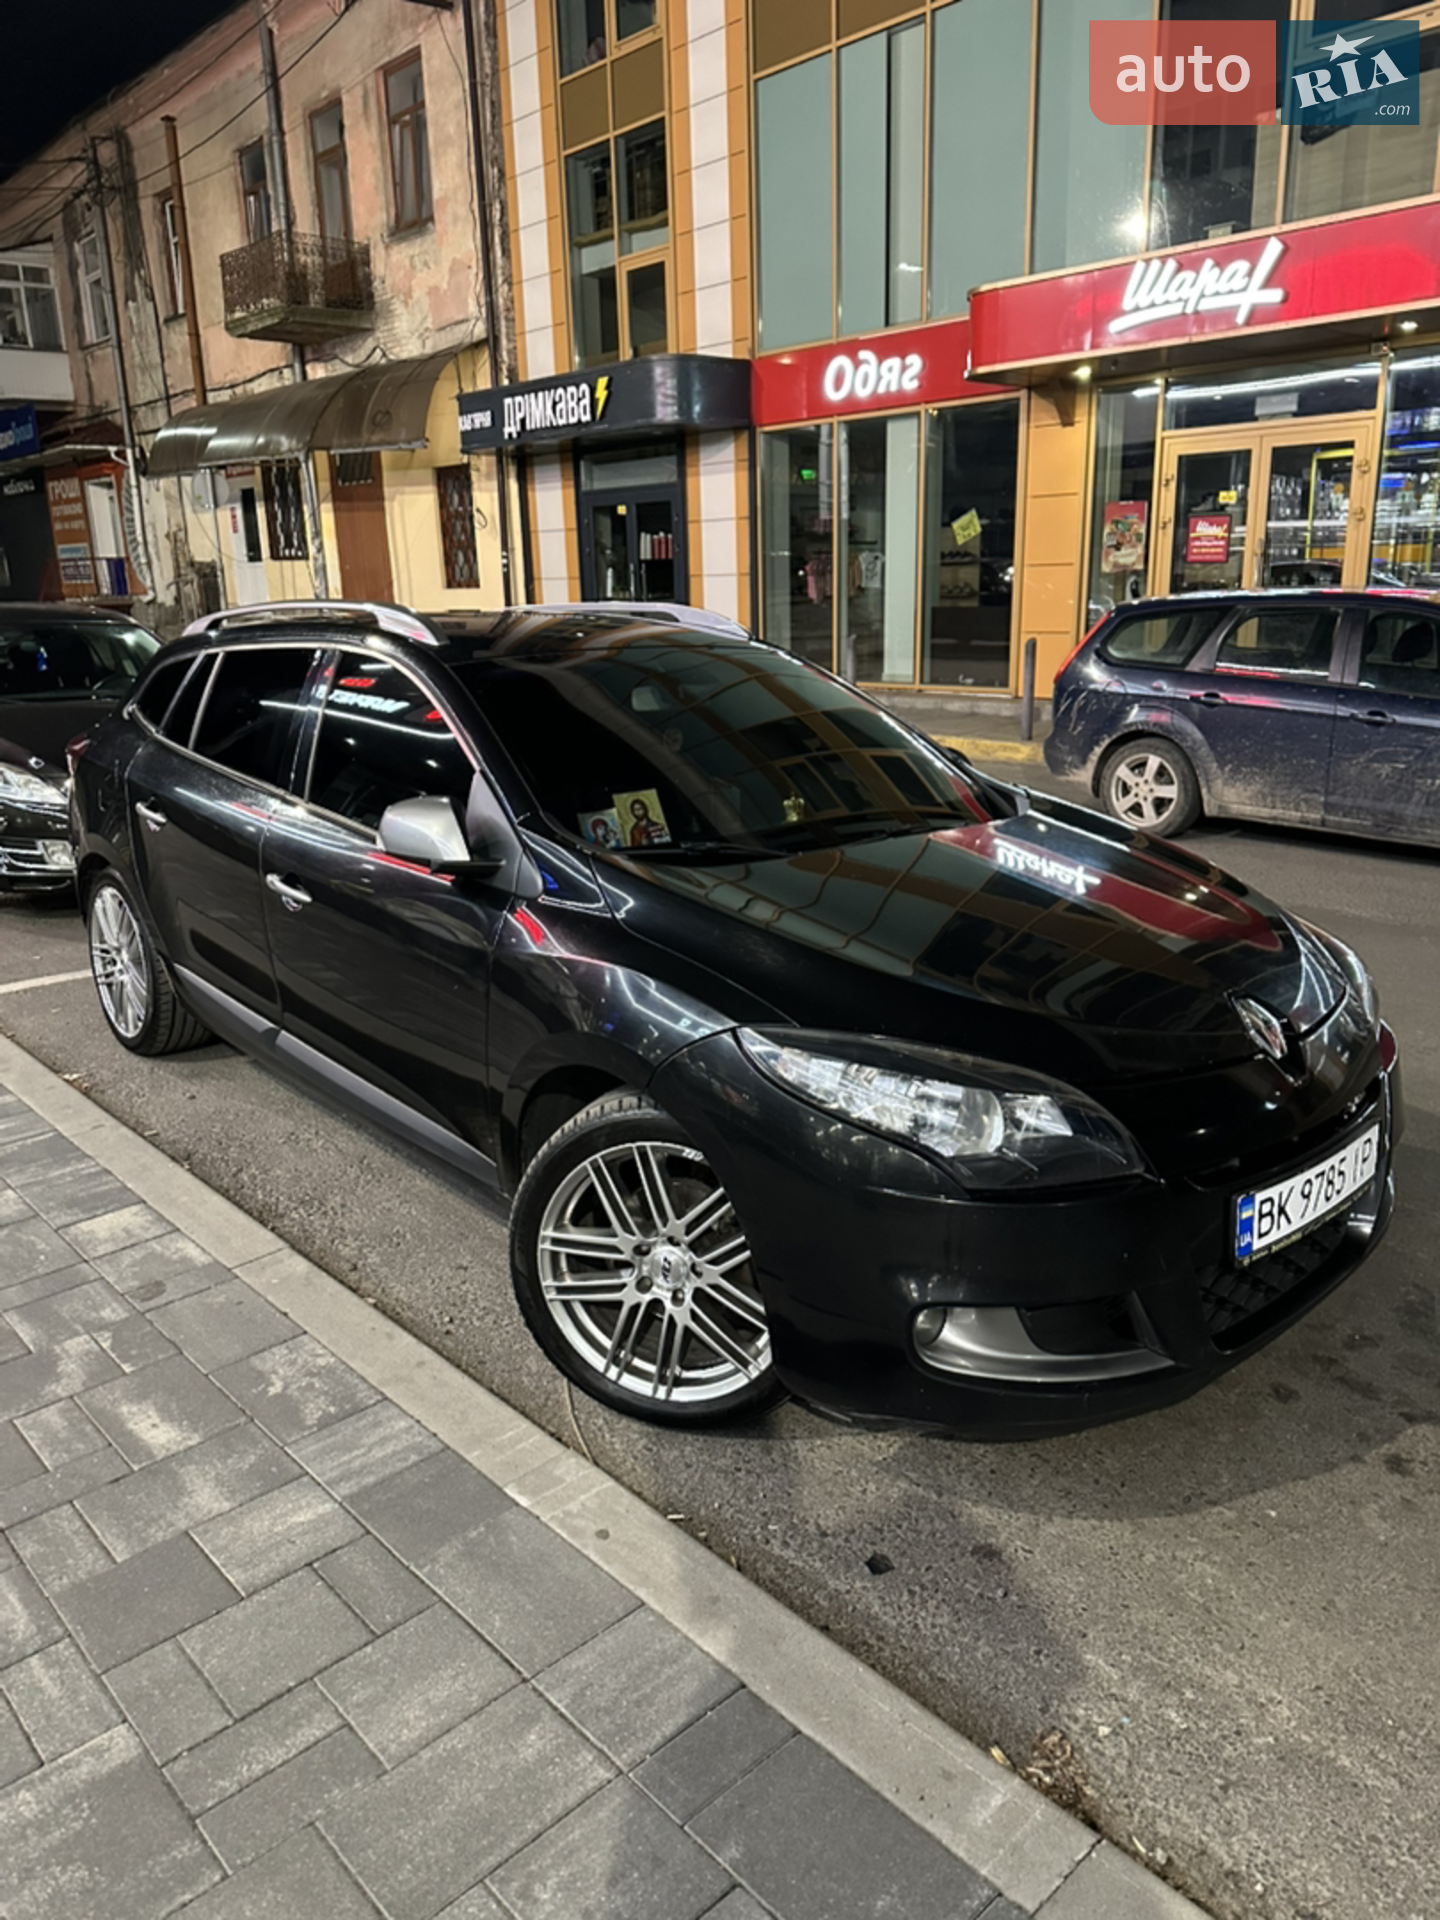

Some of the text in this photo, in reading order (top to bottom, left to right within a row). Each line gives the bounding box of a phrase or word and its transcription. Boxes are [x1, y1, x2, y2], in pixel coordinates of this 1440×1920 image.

[1258, 1185, 1295, 1240] BK
[1300, 1155, 1347, 1219] 9785
[1352, 1137, 1372, 1184] IP
